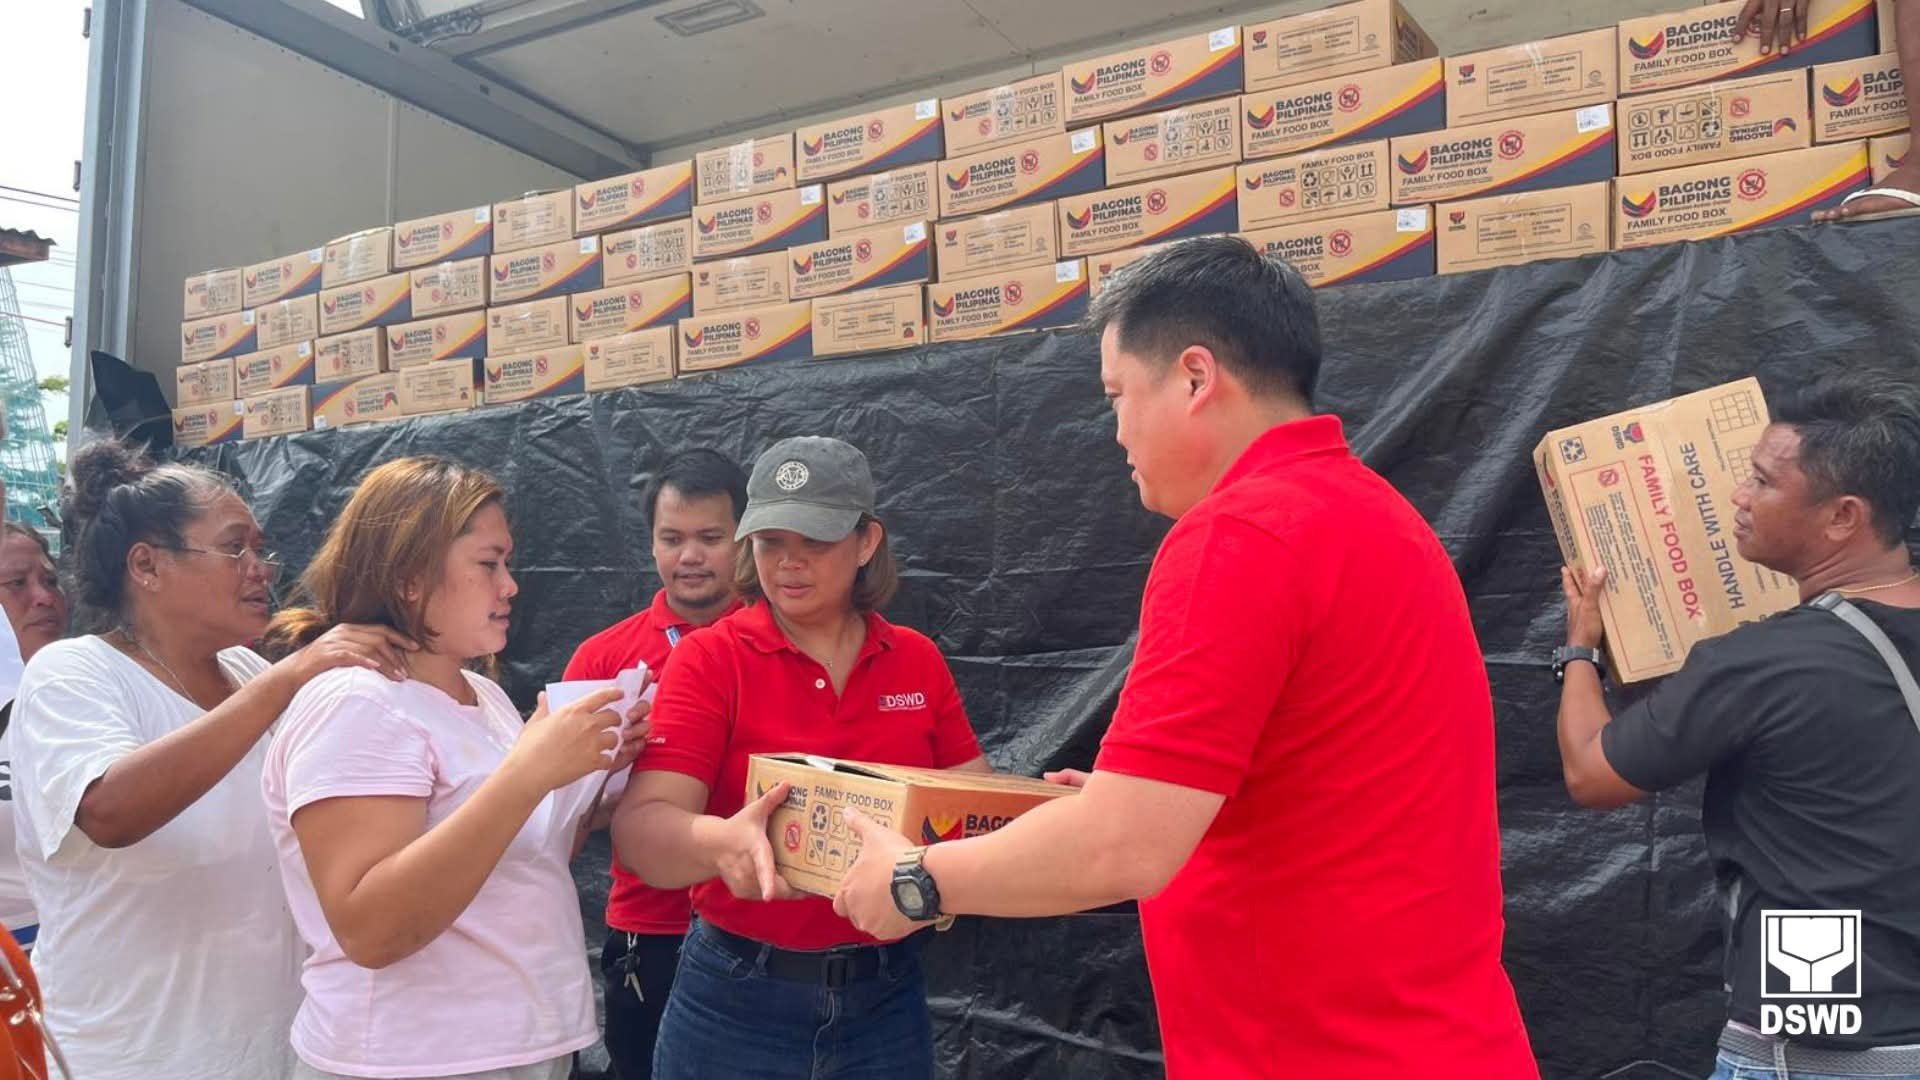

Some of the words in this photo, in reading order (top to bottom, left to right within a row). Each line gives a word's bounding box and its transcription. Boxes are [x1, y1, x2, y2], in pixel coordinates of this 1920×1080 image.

[1666, 16, 1736, 37] BAGONG
[1667, 28, 1736, 48] PILIPINAS
[1097, 59, 1146, 76] BAGONG
[1634, 58, 1672, 72] FAMILY
[1675, 52, 1706, 64] FOOD
[1709, 48, 1732, 58] BOX
[1097, 69, 1145, 85] PILIPINAS
[1863, 68, 1902, 84] BAG
[1074, 92, 1099, 103] FAMILY
[1102, 88, 1123, 98] FOOD
[1126, 84, 1142, 94] BOX
[1864, 81, 1904, 96] PILIP
[1276, 92, 1332, 110] BAGONG
[1277, 102, 1333, 120] PILIPINAS
[1830, 105, 1870, 120] FAMILY
[1874, 100, 1906, 112] FOOD
[1251, 128, 1280, 140] FAMILY
[1283, 124, 1308, 134] FOOD
[1310, 120, 1330, 129] BOX
[1430, 138, 1492, 155] BAGONG
[1654, 148, 1682, 158] FOOD
[1302, 158, 1329, 170] FAMILY
[1332, 154, 1354, 165] FOOD
[1357, 151, 1375, 160] BOX
[1431, 149, 1492, 165] PILIPINAS
[1631, 152, 1652, 161] BOX
[970, 157, 1016, 174] BAGONG
[970, 166, 1016, 182] PILIPINAS
[1263, 168, 1295, 179] BAGONG
[1402, 174, 1434, 186] FAMILY
[1437, 169, 1465, 181] FOOD
[1467, 166, 1488, 176] BOX
[950, 190, 974, 200] FAMILY
[976, 186, 997, 196] FOOD
[999, 182, 1013, 191] BOX
[1659, 177, 1730, 196] BAGONG
[1092, 196, 1141, 212] BAGONG
[1660, 189, 1731, 207] PILIPINAS
[1093, 206, 1142, 221] PILIPINAS
[1627, 218, 1664, 230] FAMILY
[1668, 211, 1699, 224] FOOD
[1702, 208, 1726, 218] BOX
[1071, 228, 1097, 239] FAMILY
[1099, 225, 1121, 236] FOOD
[1122, 222, 1140, 232] BOX
[1267, 236, 1323, 251] BAGONG
[1267, 246, 1323, 259] LIPINAS
[1301, 264, 1320, 272] BOX
[955, 287, 1000, 300] BAGONG
[956, 296, 1000, 309] PILIPINAS
[937, 316, 960, 326] FAMILY
[962, 314, 981, 323] FOOD
[983, 312, 998, 320] BOX
[1679, 442, 1706, 489] CARE
[1696, 495, 1722, 537] WITH
[1638, 454, 1672, 518] FAMILY
[1660, 521, 1688, 574] FOOD
[1678, 578, 1703, 620] BOX
[1710, 539, 1746, 610] HANDLE
[886, 692, 925, 708] DSWD
[814, 786, 844, 800] FAMILY
[845, 793, 872, 805] FOOD
[874, 800, 894, 811] BOX
[966, 814, 1014, 831] BAG
